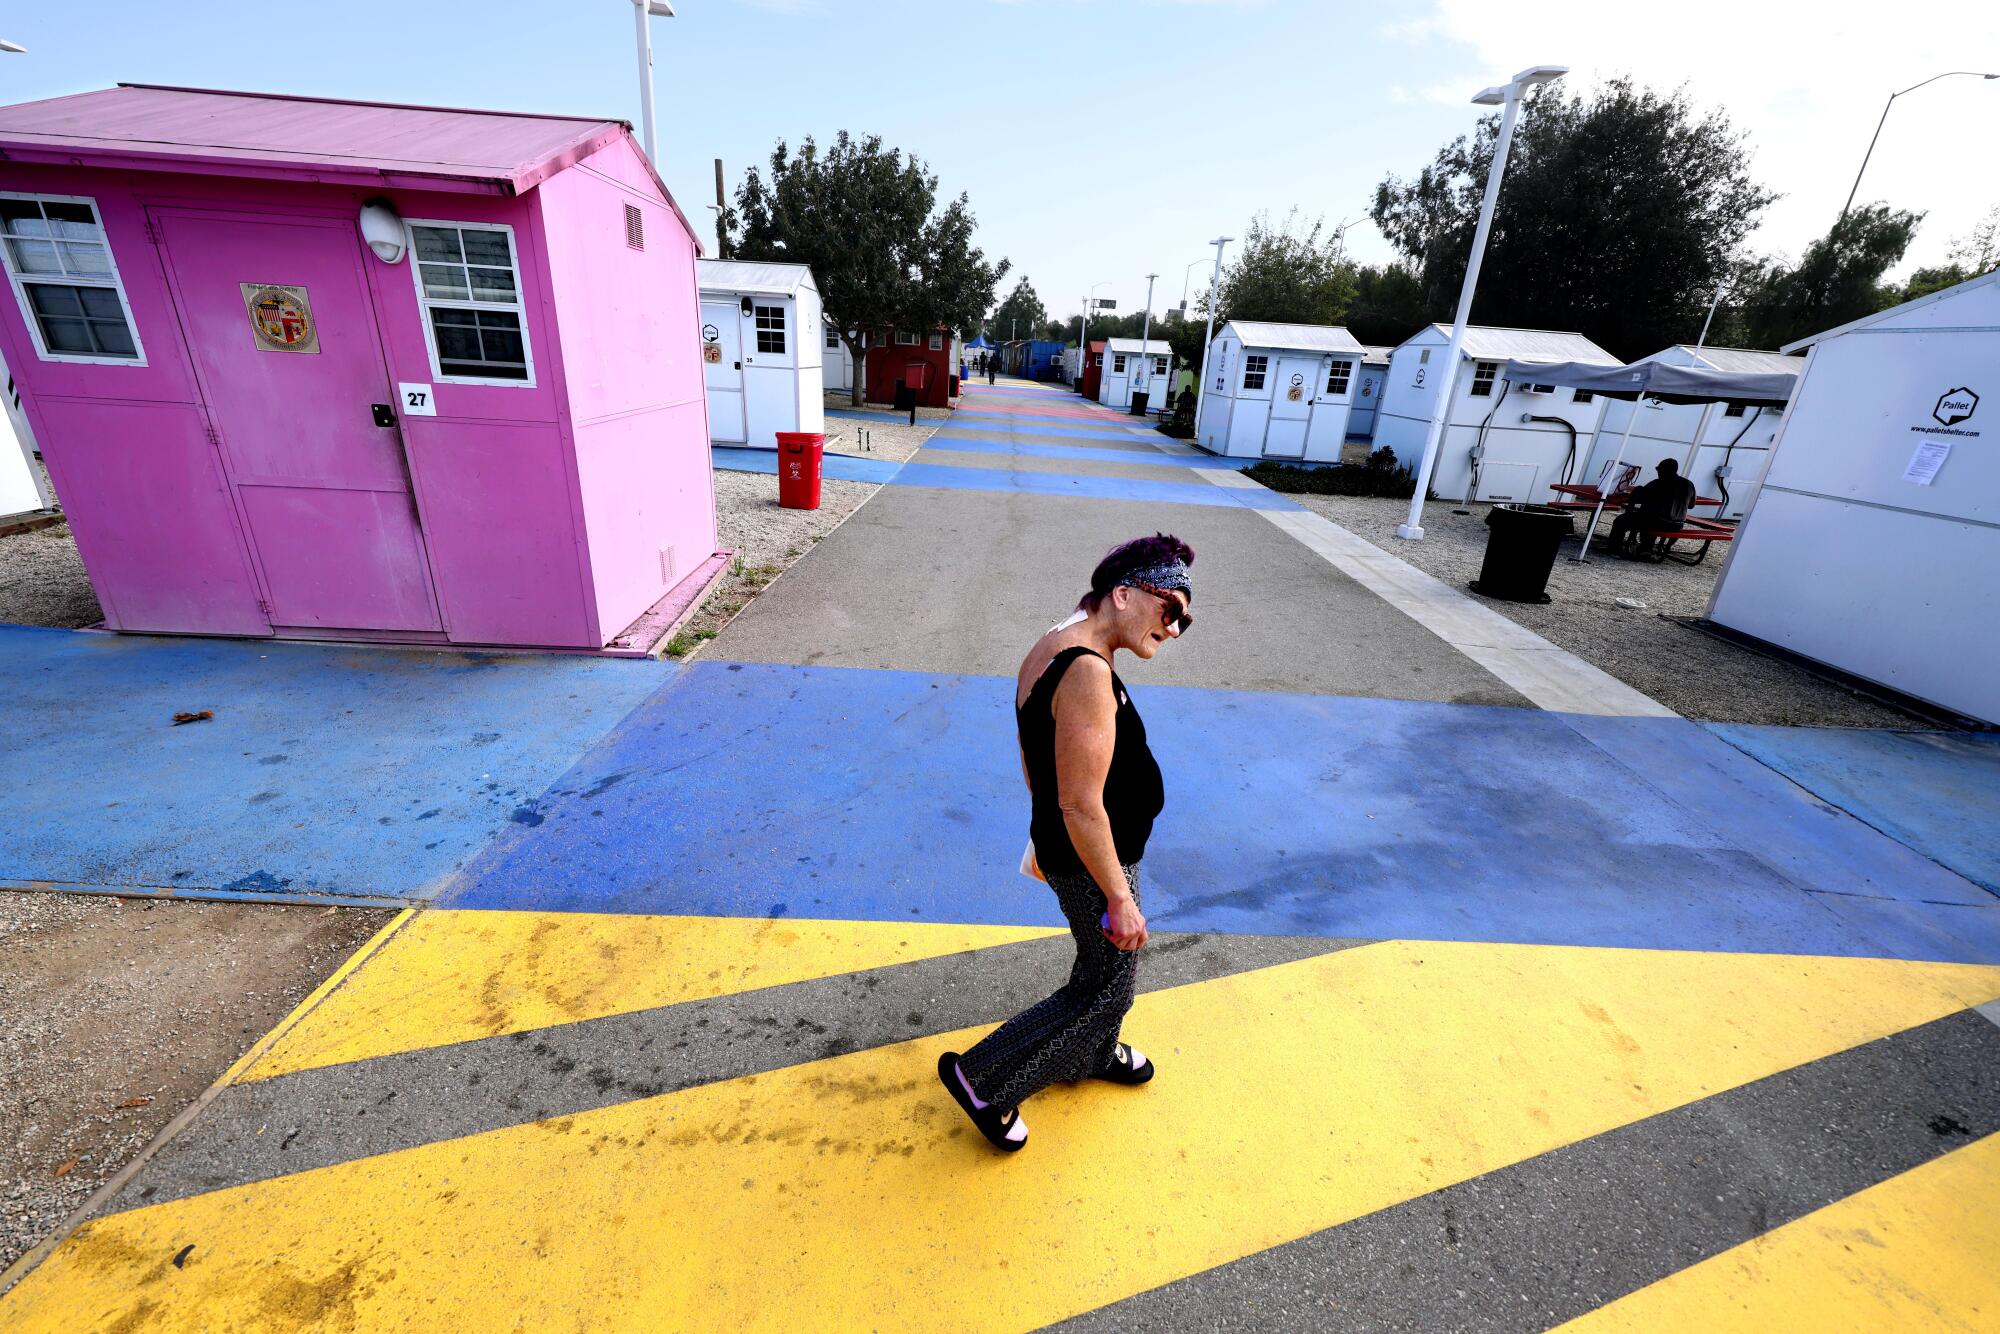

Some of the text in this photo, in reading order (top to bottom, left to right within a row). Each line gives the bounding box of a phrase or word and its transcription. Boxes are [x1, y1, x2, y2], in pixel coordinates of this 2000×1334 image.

[407, 392, 426, 406] 27
[1942, 401, 1970, 410] Pallet
[1910, 426, 1981, 437] www.palletshelter.com
